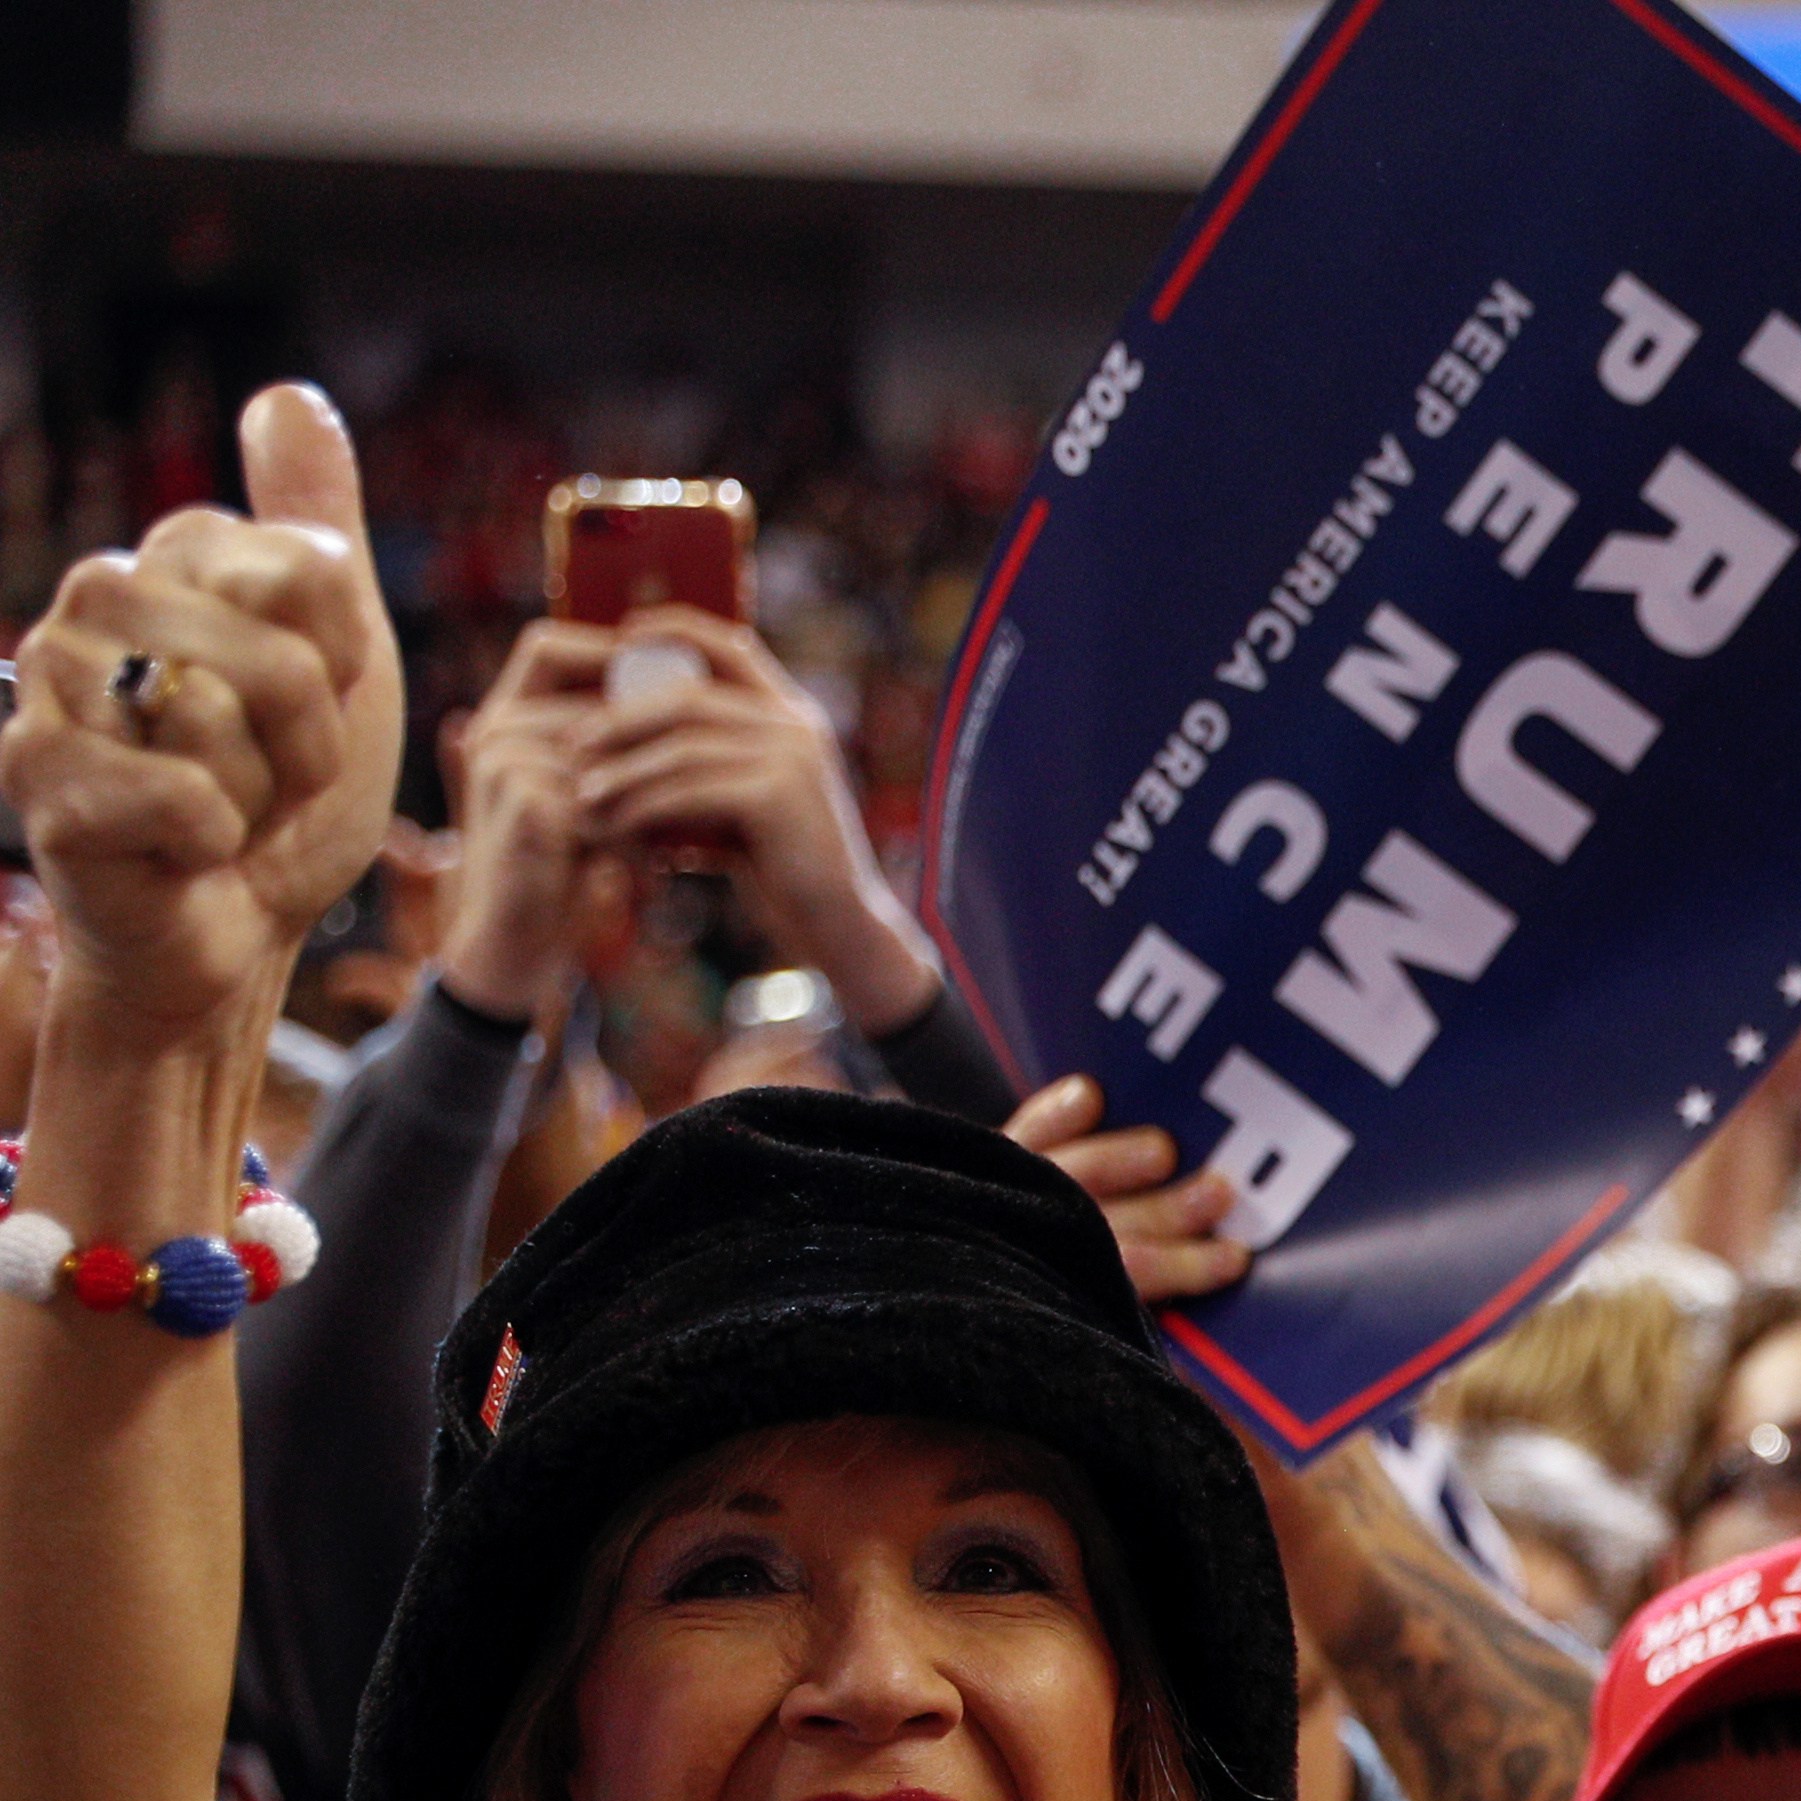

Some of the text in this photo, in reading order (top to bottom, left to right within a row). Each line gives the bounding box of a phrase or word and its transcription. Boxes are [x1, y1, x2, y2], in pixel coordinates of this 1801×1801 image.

[1052, 340, 1144, 476] 2020
[1077, 278, 1536, 906] KEEP AMERICA GREAT!
[1096, 271, 1699, 1060] PENCE
[1636, 1570, 1762, 1661] MAKE
